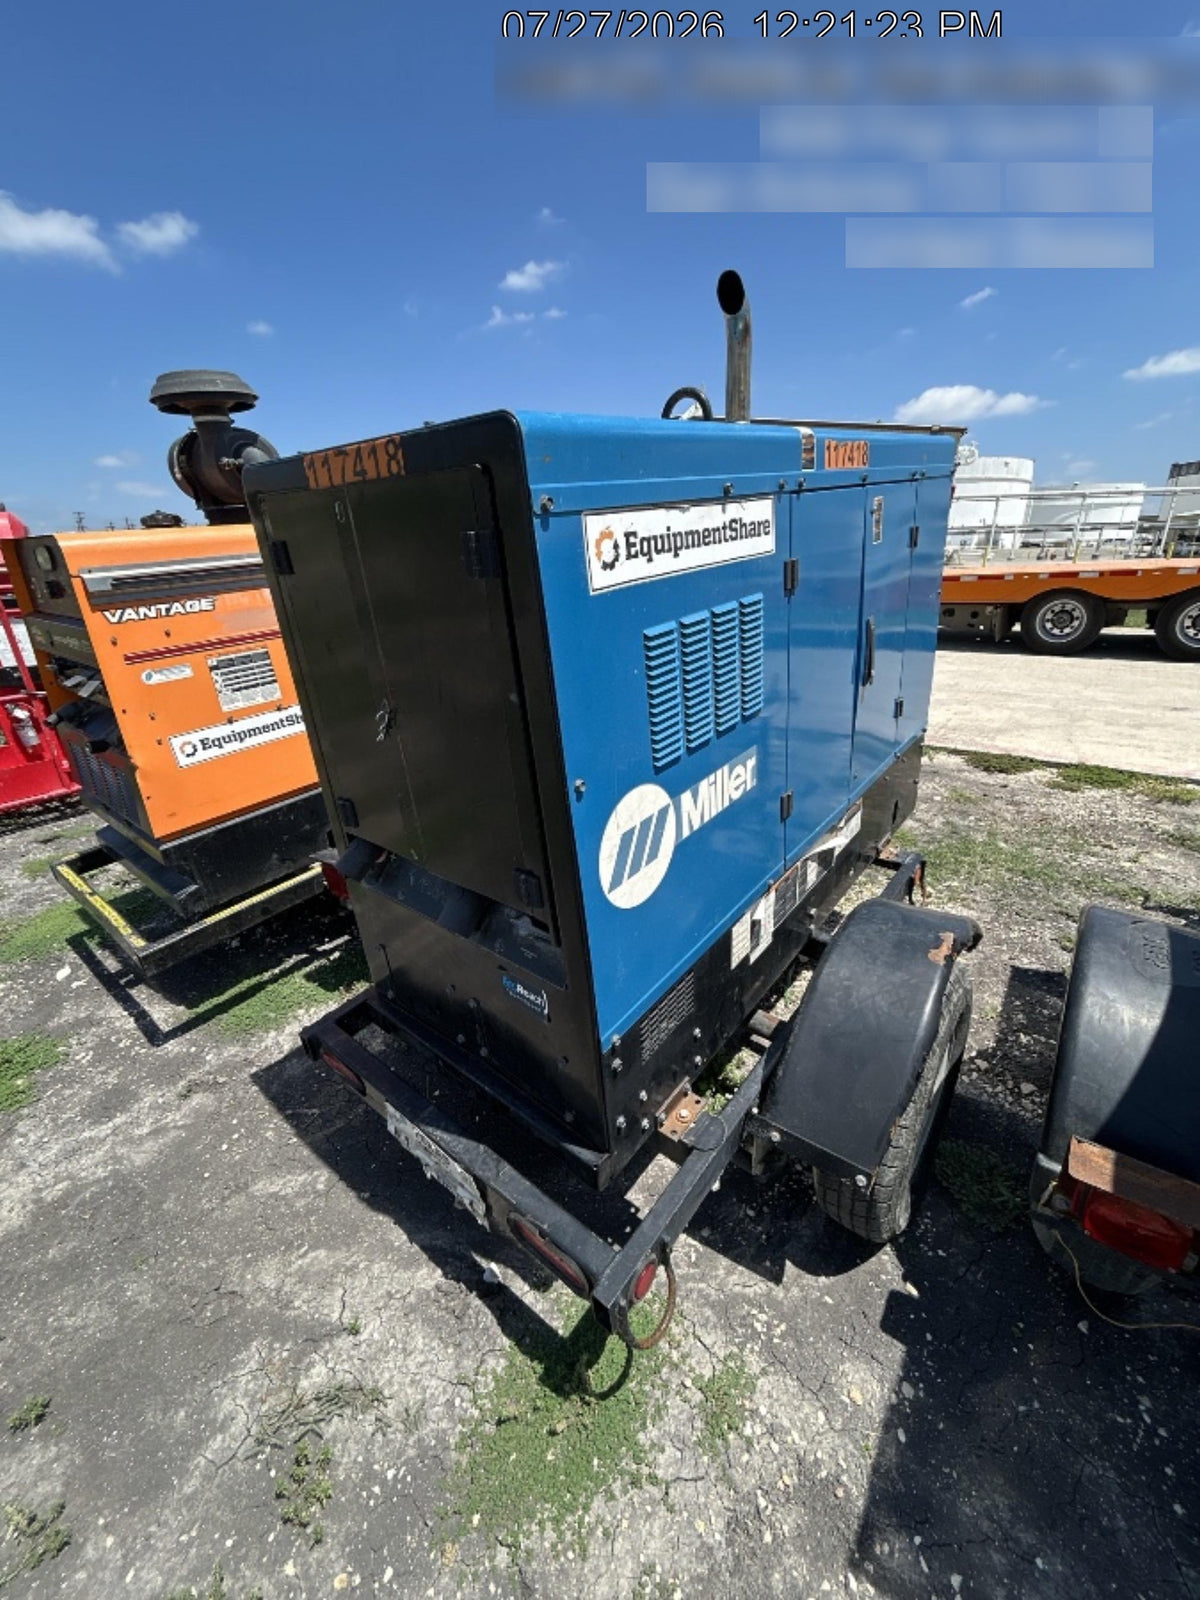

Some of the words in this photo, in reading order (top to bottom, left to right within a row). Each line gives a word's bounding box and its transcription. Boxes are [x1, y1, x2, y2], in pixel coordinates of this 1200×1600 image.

[307, 437, 405, 488] 117418
[825, 440, 868, 470] 117418
[624, 517, 771, 564] EquipmentShare
[102, 596, 216, 625] VANTAGE
[199, 711, 304, 751] EquipmentSh
[680, 755, 757, 840] Miller
